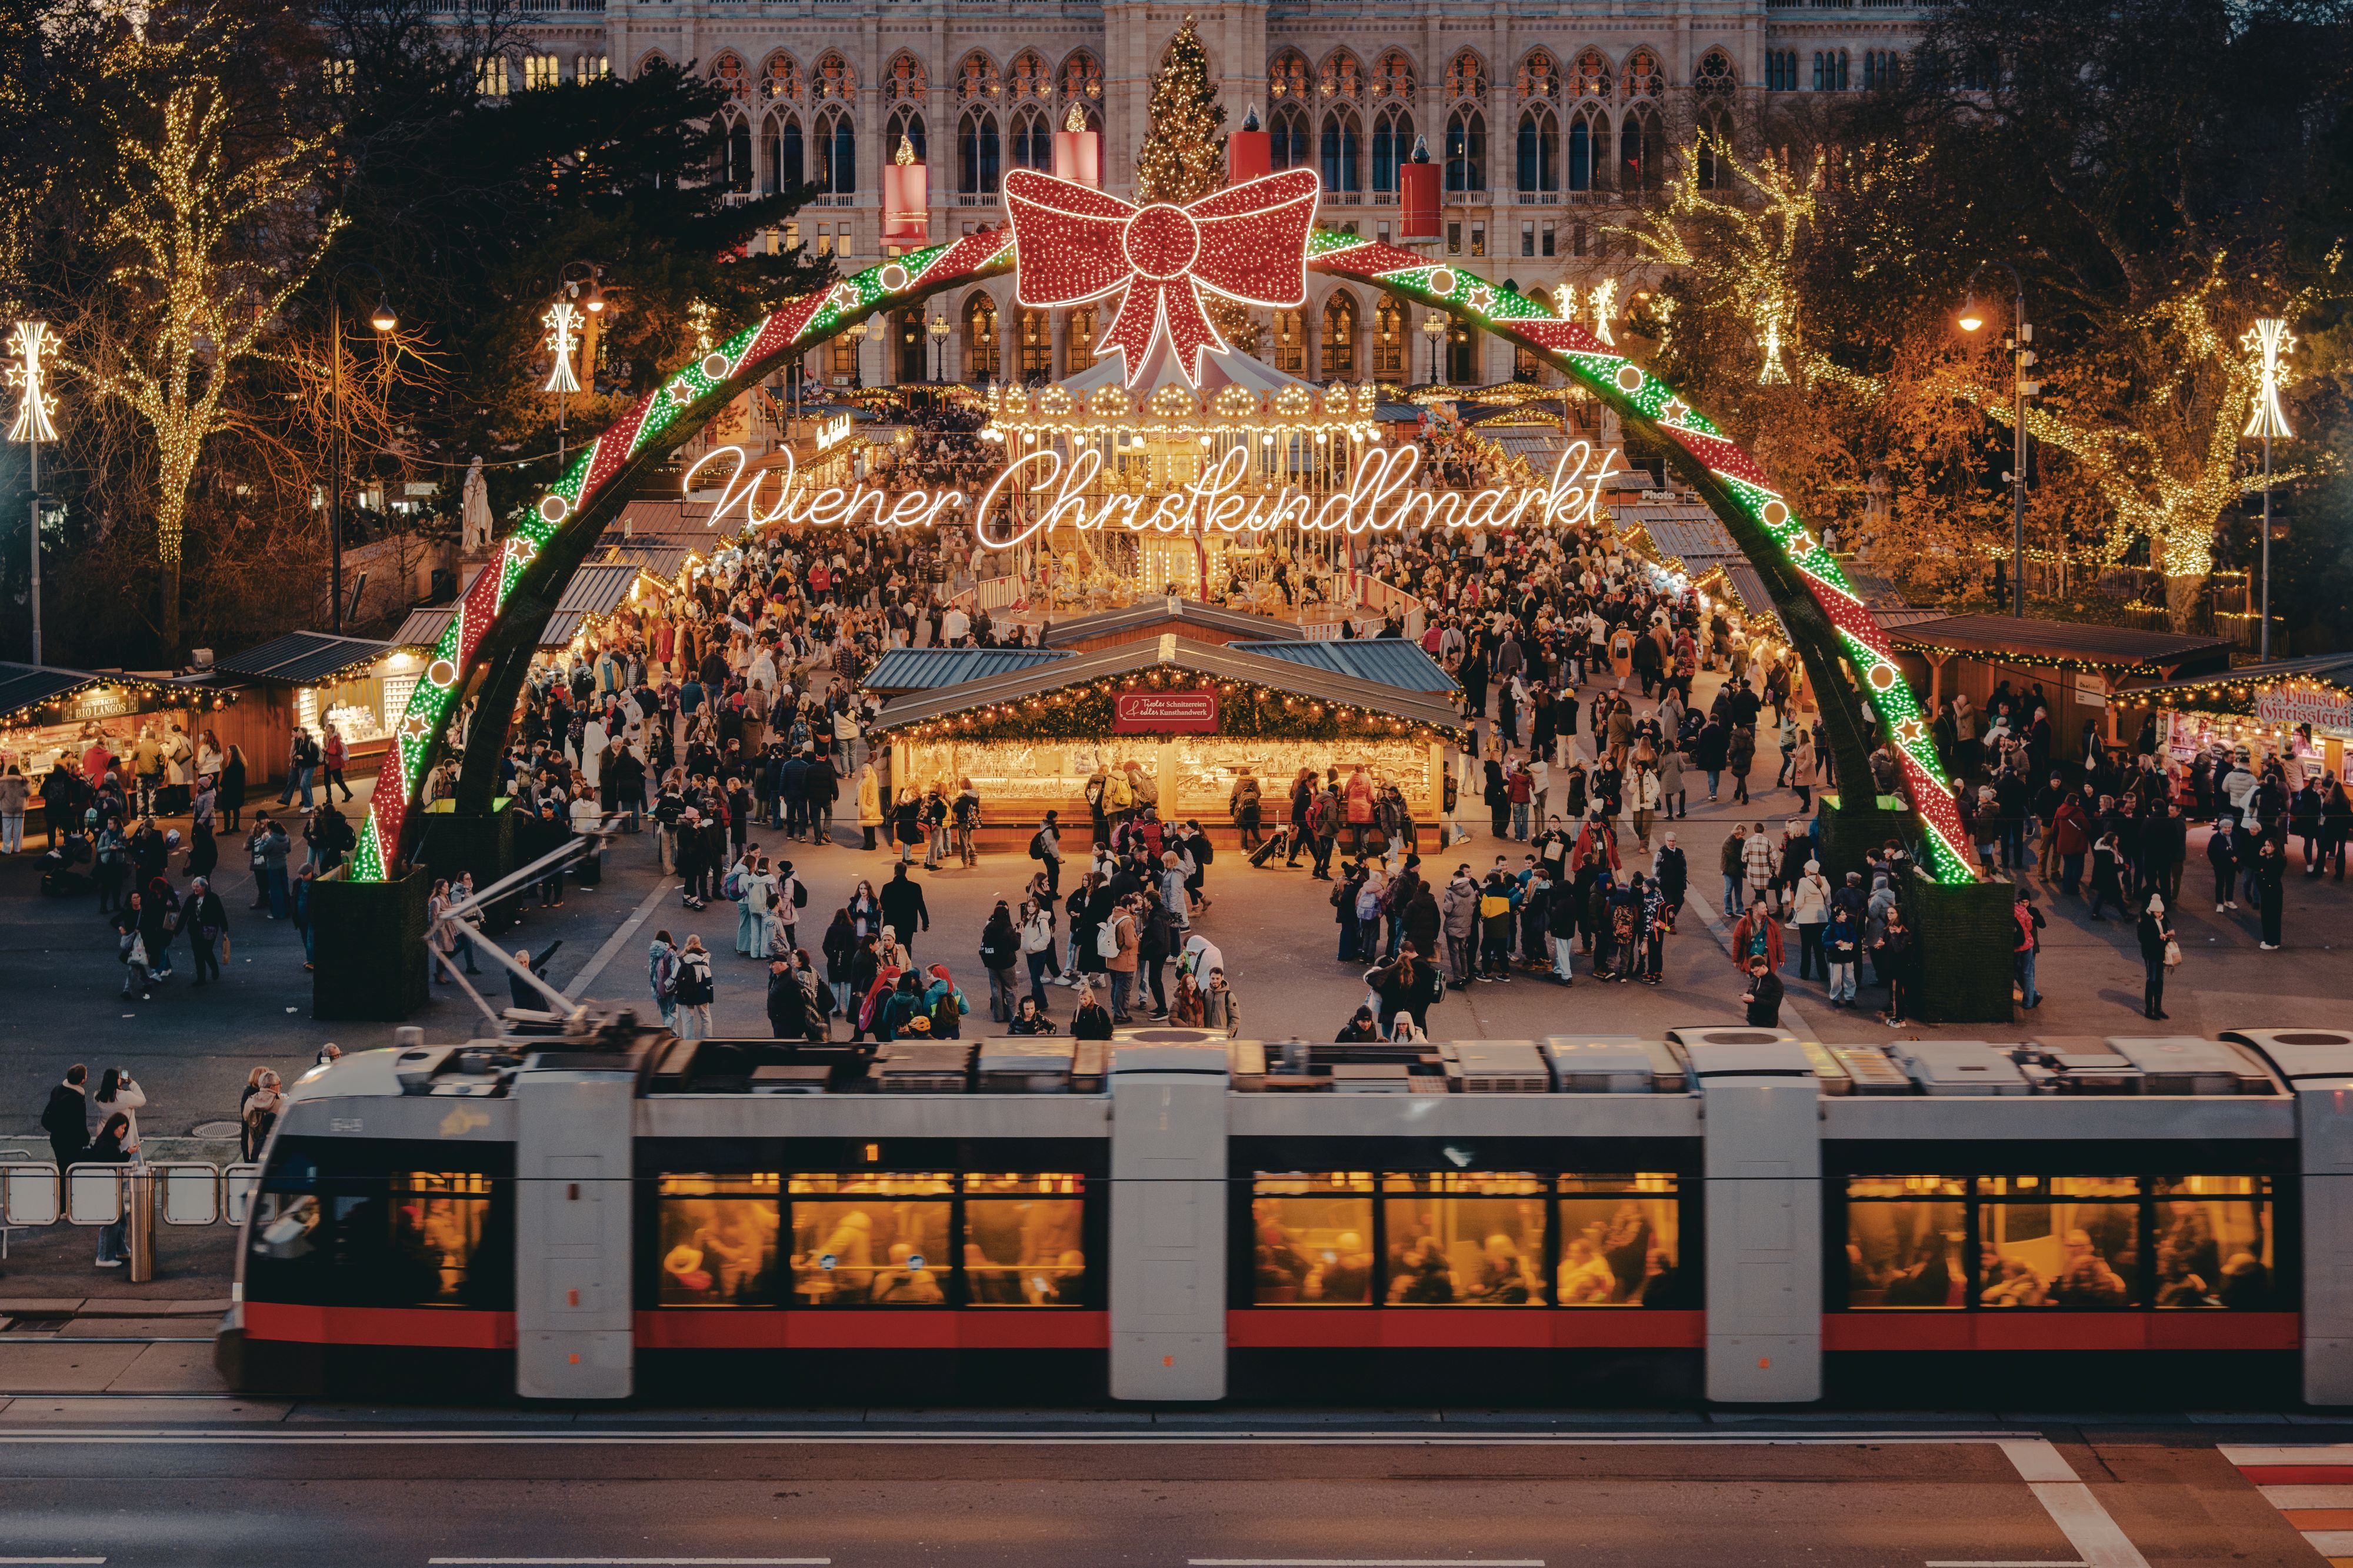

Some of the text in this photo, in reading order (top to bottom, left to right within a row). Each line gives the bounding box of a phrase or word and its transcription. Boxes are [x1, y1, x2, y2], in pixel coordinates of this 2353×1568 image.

[683, 441, 1619, 548] Wiener Christkindlmarkt
[1642, 490, 1676, 500] Photo
[1141, 699, 1165, 707] Tiroler
[2279, 685, 2344, 710] Punsch
[75, 707, 92, 719] BIO
[1139, 707, 1159, 716] edles
[2260, 700, 2350, 727] Greisslerei
